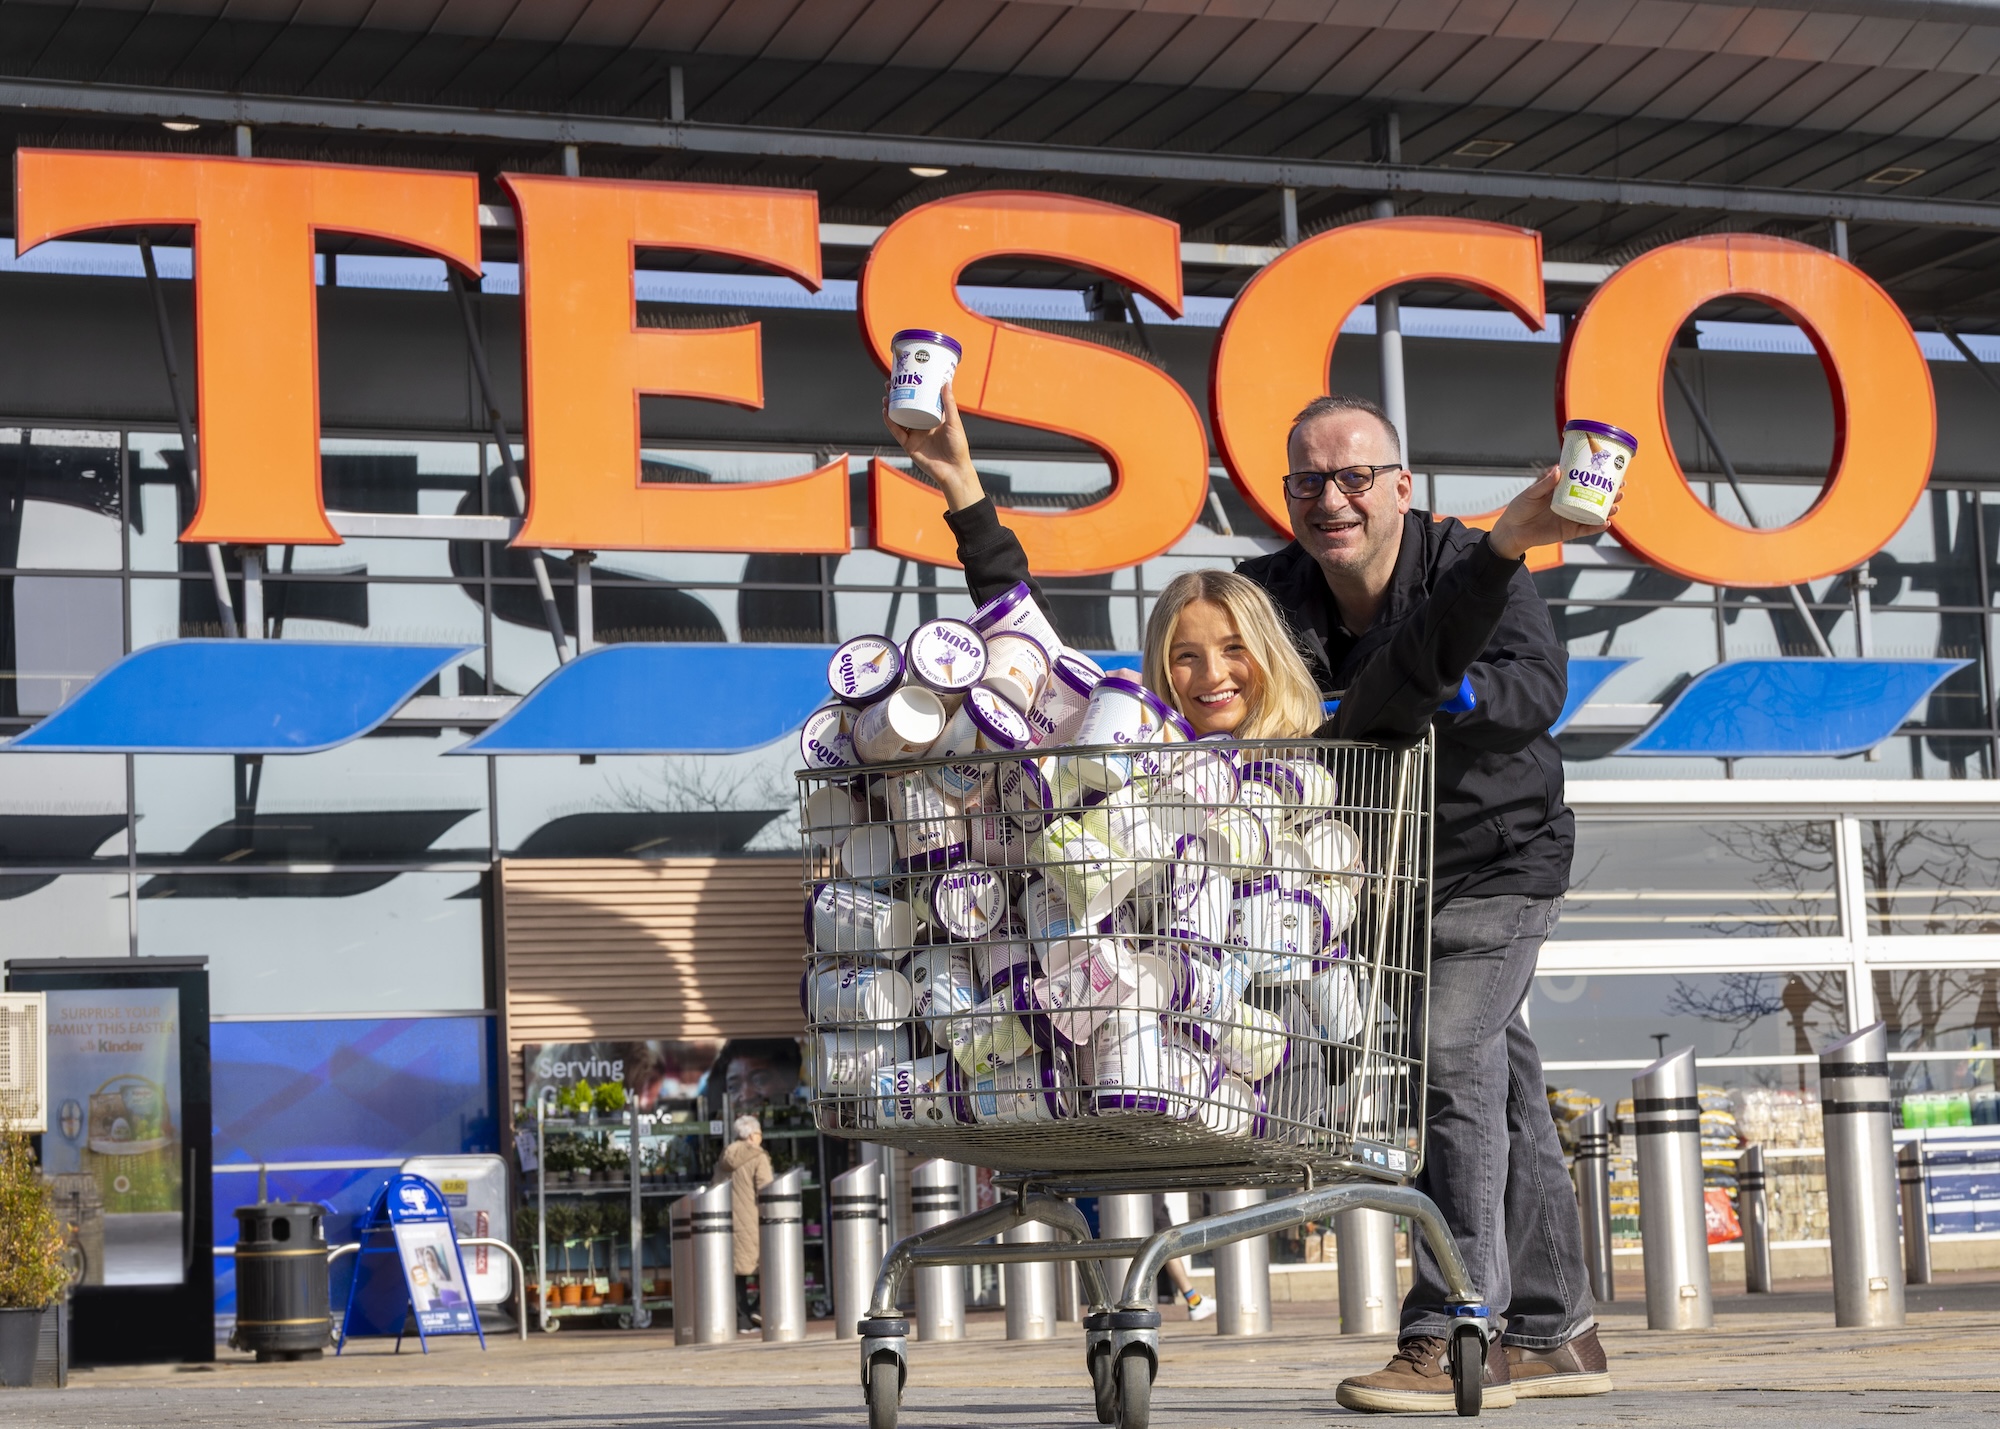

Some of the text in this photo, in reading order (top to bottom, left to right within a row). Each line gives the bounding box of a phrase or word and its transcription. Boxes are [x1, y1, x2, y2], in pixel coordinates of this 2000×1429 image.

[15, 147, 1938, 588] TESCO
[892, 371, 923, 390] qui's
[1027, 705, 1057, 734] qui's
[61, 1006, 161, 1020] SURPRISE YOUR
[48, 1021, 176, 1036] FAMILY THIS EASTER
[98, 1039, 144, 1053] Kinder
[540, 1056, 625, 1082] Serving
